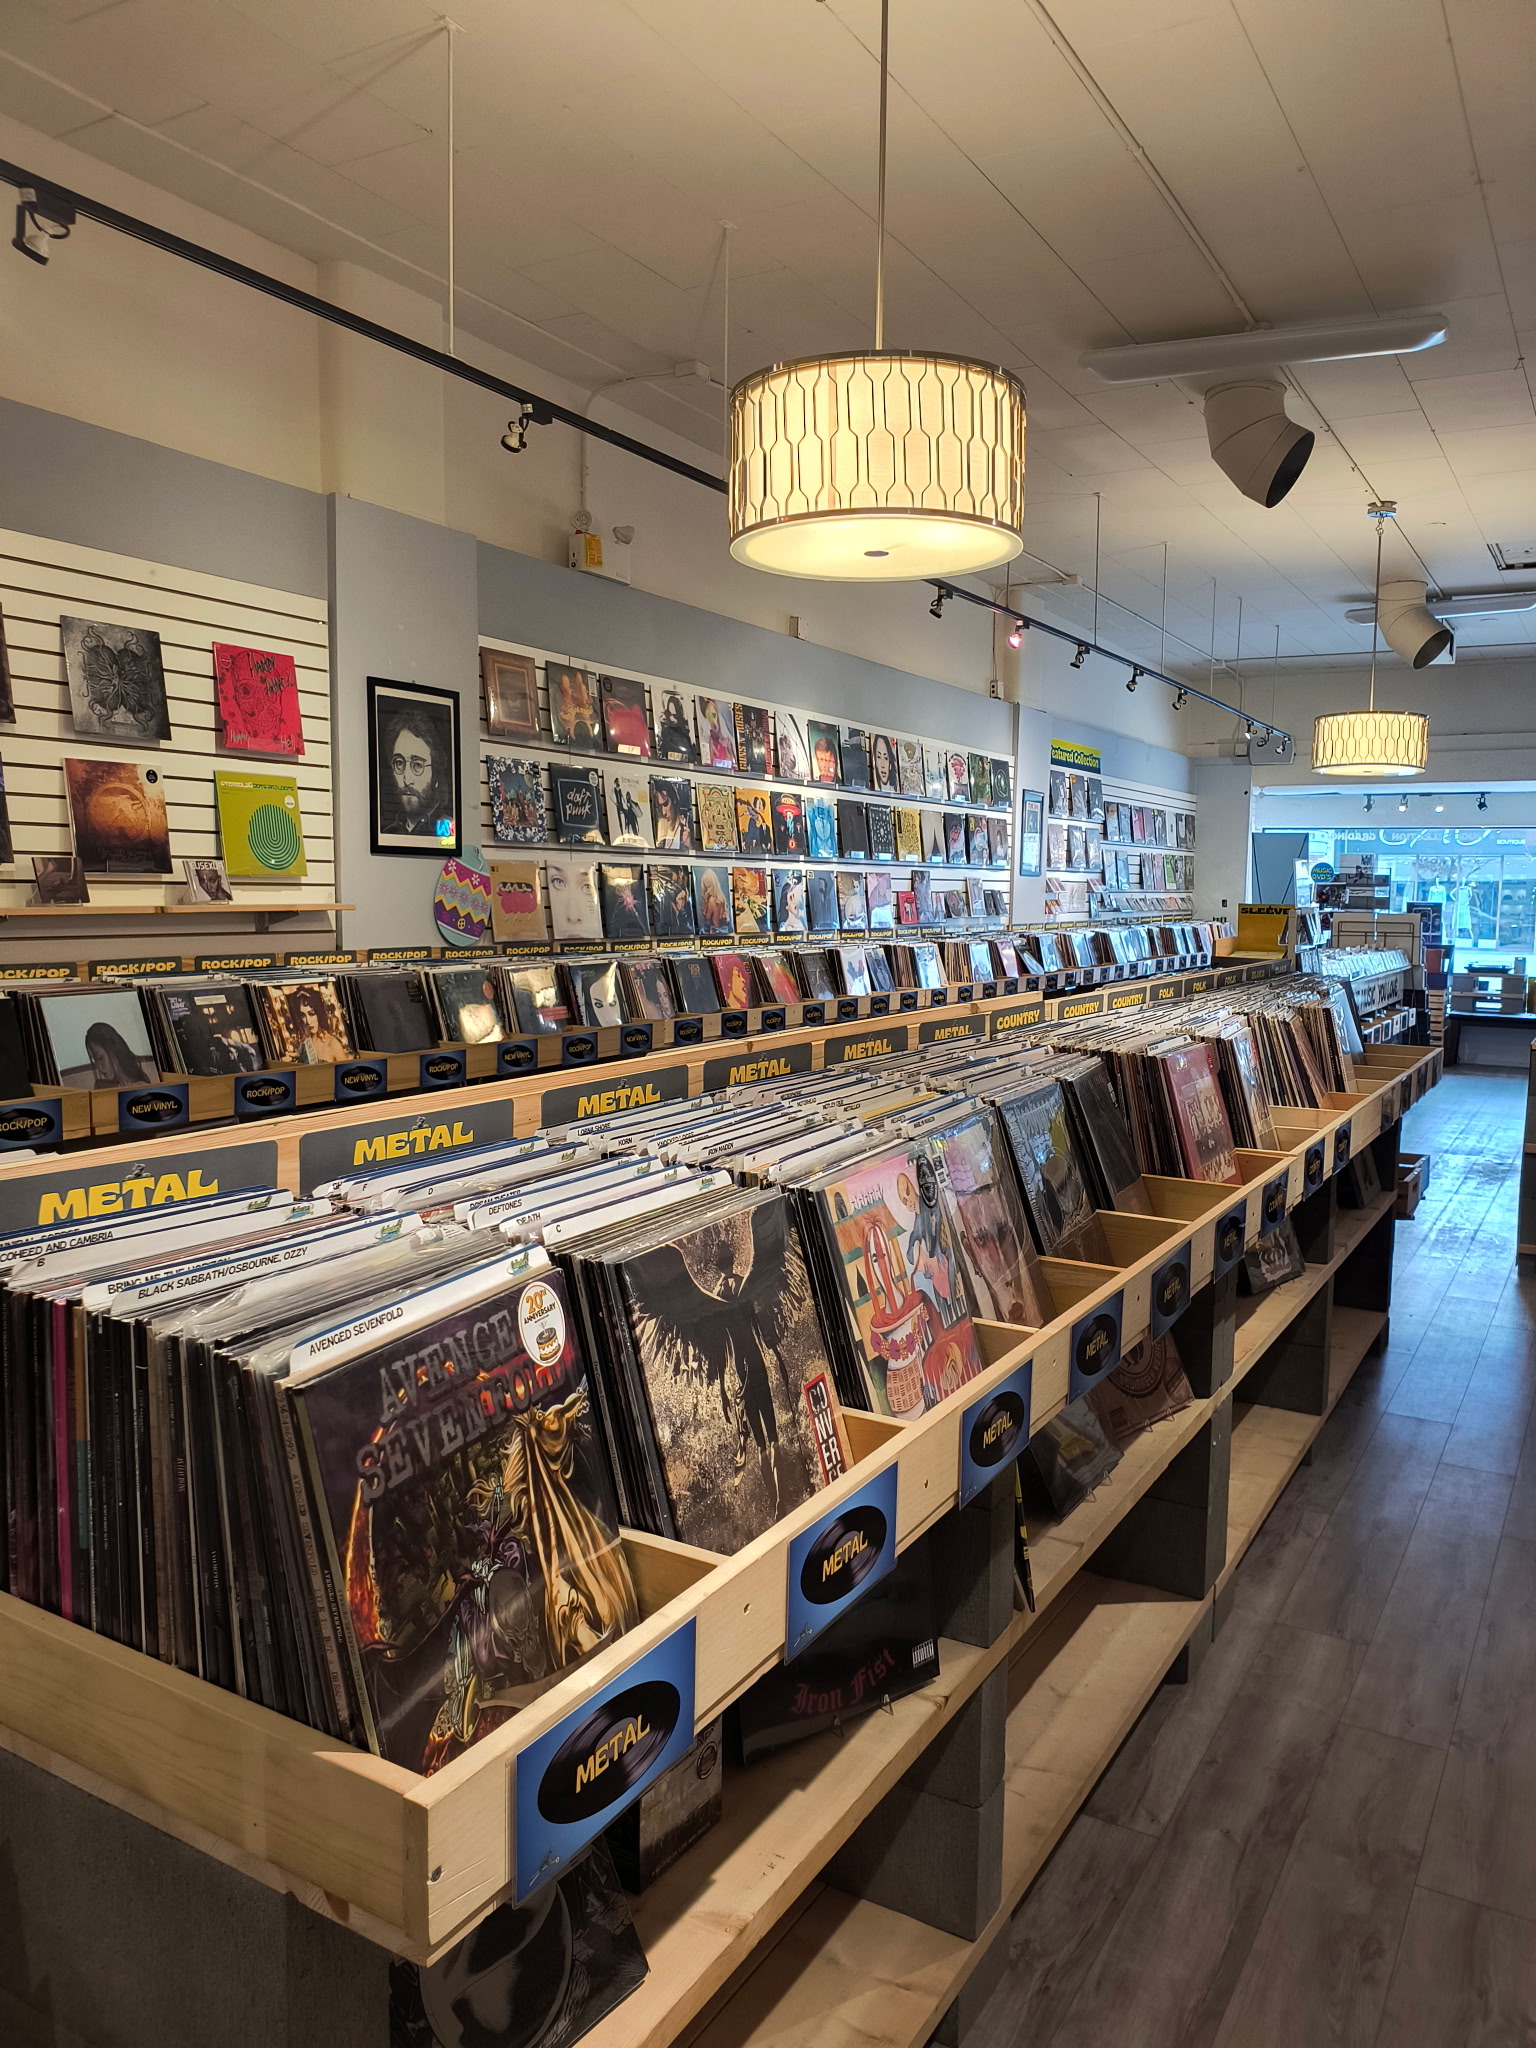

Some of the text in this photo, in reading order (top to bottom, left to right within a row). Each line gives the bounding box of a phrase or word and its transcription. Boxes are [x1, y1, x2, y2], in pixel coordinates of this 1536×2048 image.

[567, 788, 592, 804] daft
[566, 802, 592, 816] punk
[191, 861, 224, 870] EUSEXUA
[614, 944, 650, 952] ROCK/POP
[741, 937, 770, 945] ROCK/POP
[372, 950, 428, 960] ROCK/POP
[445, 950, 494, 959] ROCK/POP
[506, 947, 550, 955] ROCK/POP
[201, 958, 271, 970] ROCK/POP
[290, 954, 352, 965] ROCK/POP
[97, 961, 176, 976] ROCK/POP
[1158, 987, 1174, 1000] FOLK
[1192, 981, 1207, 992] FOLK
[1112, 993, 1144, 1009] COUNTRY
[1064, 1001, 1099, 1019] COUNTRY
[996, 1010, 1041, 1030] COUNTRY
[935, 1025, 973, 1041] METAL
[504, 1050, 532, 1061] NEW VINYL
[568, 1043, 592, 1054] ROCK/POP
[844, 1039, 892, 1061] METAL
[429, 1063, 459, 1074] ROCK/POP
[729, 1058, 791, 1085] METAL
[344, 1073, 379, 1085] NEW VINYL
[246, 1086, 286, 1099] ROCK/POP
[131, 1100, 178, 1114] NEW VINYL
[577, 1084, 661, 1118] METAL
[594, 1121, 611, 1133] SHORE
[353, 1122, 474, 1166] METAL
[618, 1137, 633, 1147] KORN
[362, 1183, 368, 1192] F
[428, 1187, 434, 1195] D
[38, 1170, 219, 1226] METAL
[488, 1199, 523, 1216] DEFTONES
[516, 1212, 542, 1226] DEATH
[555, 1224, 562, 1233] C
[0, 1245, 44, 1263] COHEED
[46, 1241, 67, 1253] AND
[69, 1230, 114, 1248] CAMBRIA
[36, 1258, 46, 1268] B
[138, 1281, 175, 1300] BLACK
[176, 1253, 283, 1290] SABBATH/OSBOURNE,
[283, 1246, 308, 1262] OZZY
[1163, 1276, 1182, 1303] METAL
[523, 1302, 557, 1325] ANNIVERSARY
[309, 1306, 404, 1357] AVENGED SEVENFOLD
[1085, 1330, 1109, 1360] METAL
[379, 1308, 519, 1425] AVENGE
[356, 1361, 569, 1506] SEVENFOLD
[981, 1415, 1014, 1450] METAL
[821, 1530, 869, 1583] METAL
[790, 1682, 843, 1715] Iron
[850, 1646, 897, 1703] Fist
[575, 1713, 650, 1794] METAL
